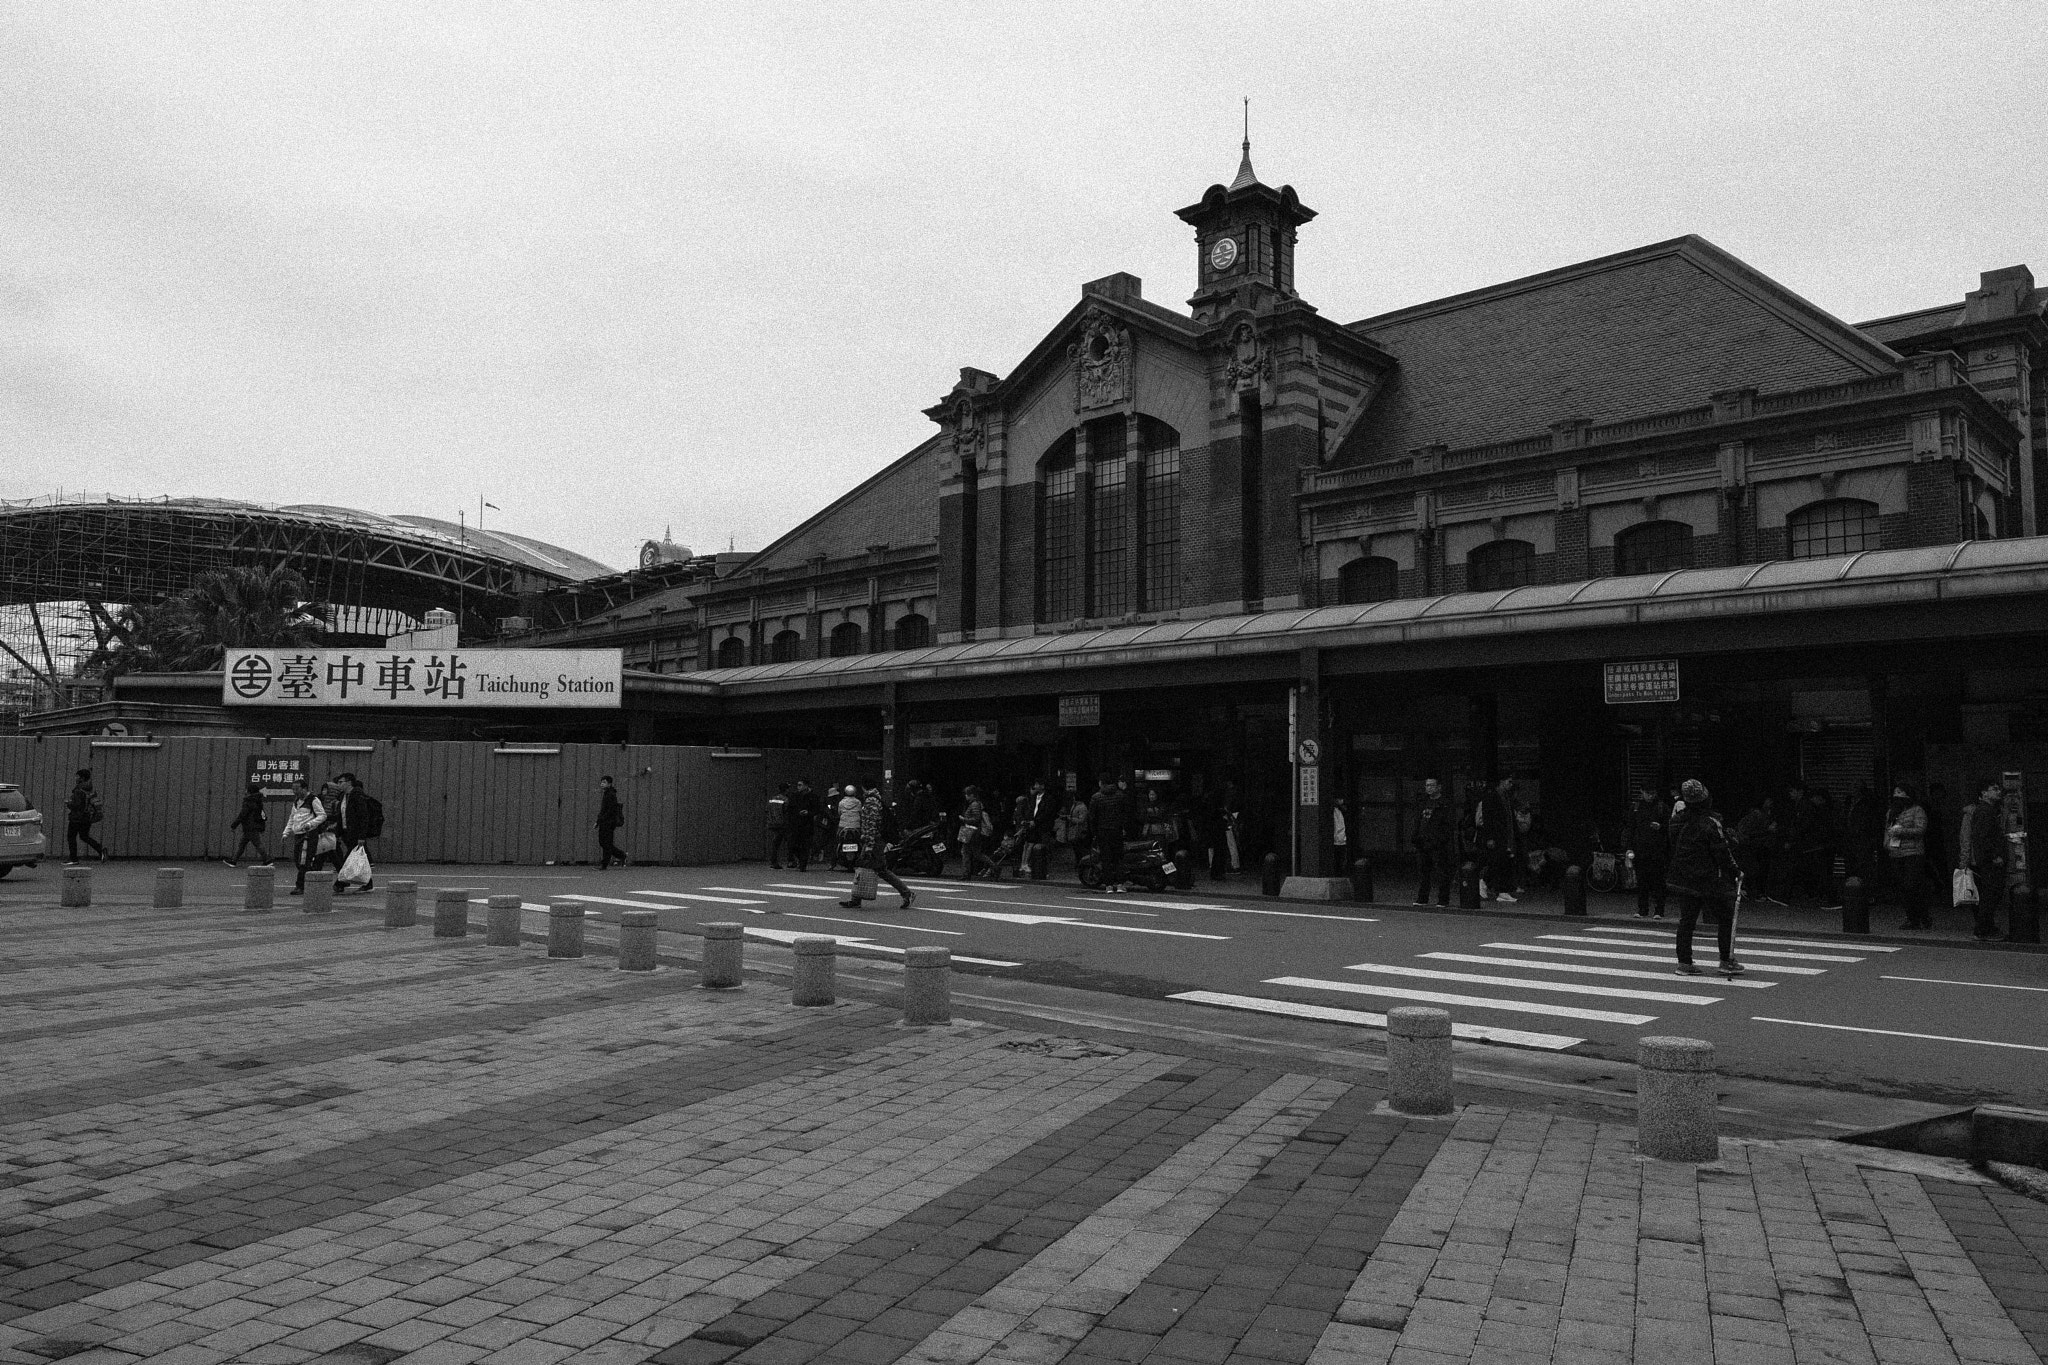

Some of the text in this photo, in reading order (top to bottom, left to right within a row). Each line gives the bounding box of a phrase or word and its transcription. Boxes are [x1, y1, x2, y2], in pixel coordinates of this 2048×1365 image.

[277, 654, 615, 700] 臺中車站 Taichung Station
[257, 760, 300, 770] 國光客運
[251, 772, 304, 783] 台中轉運站
